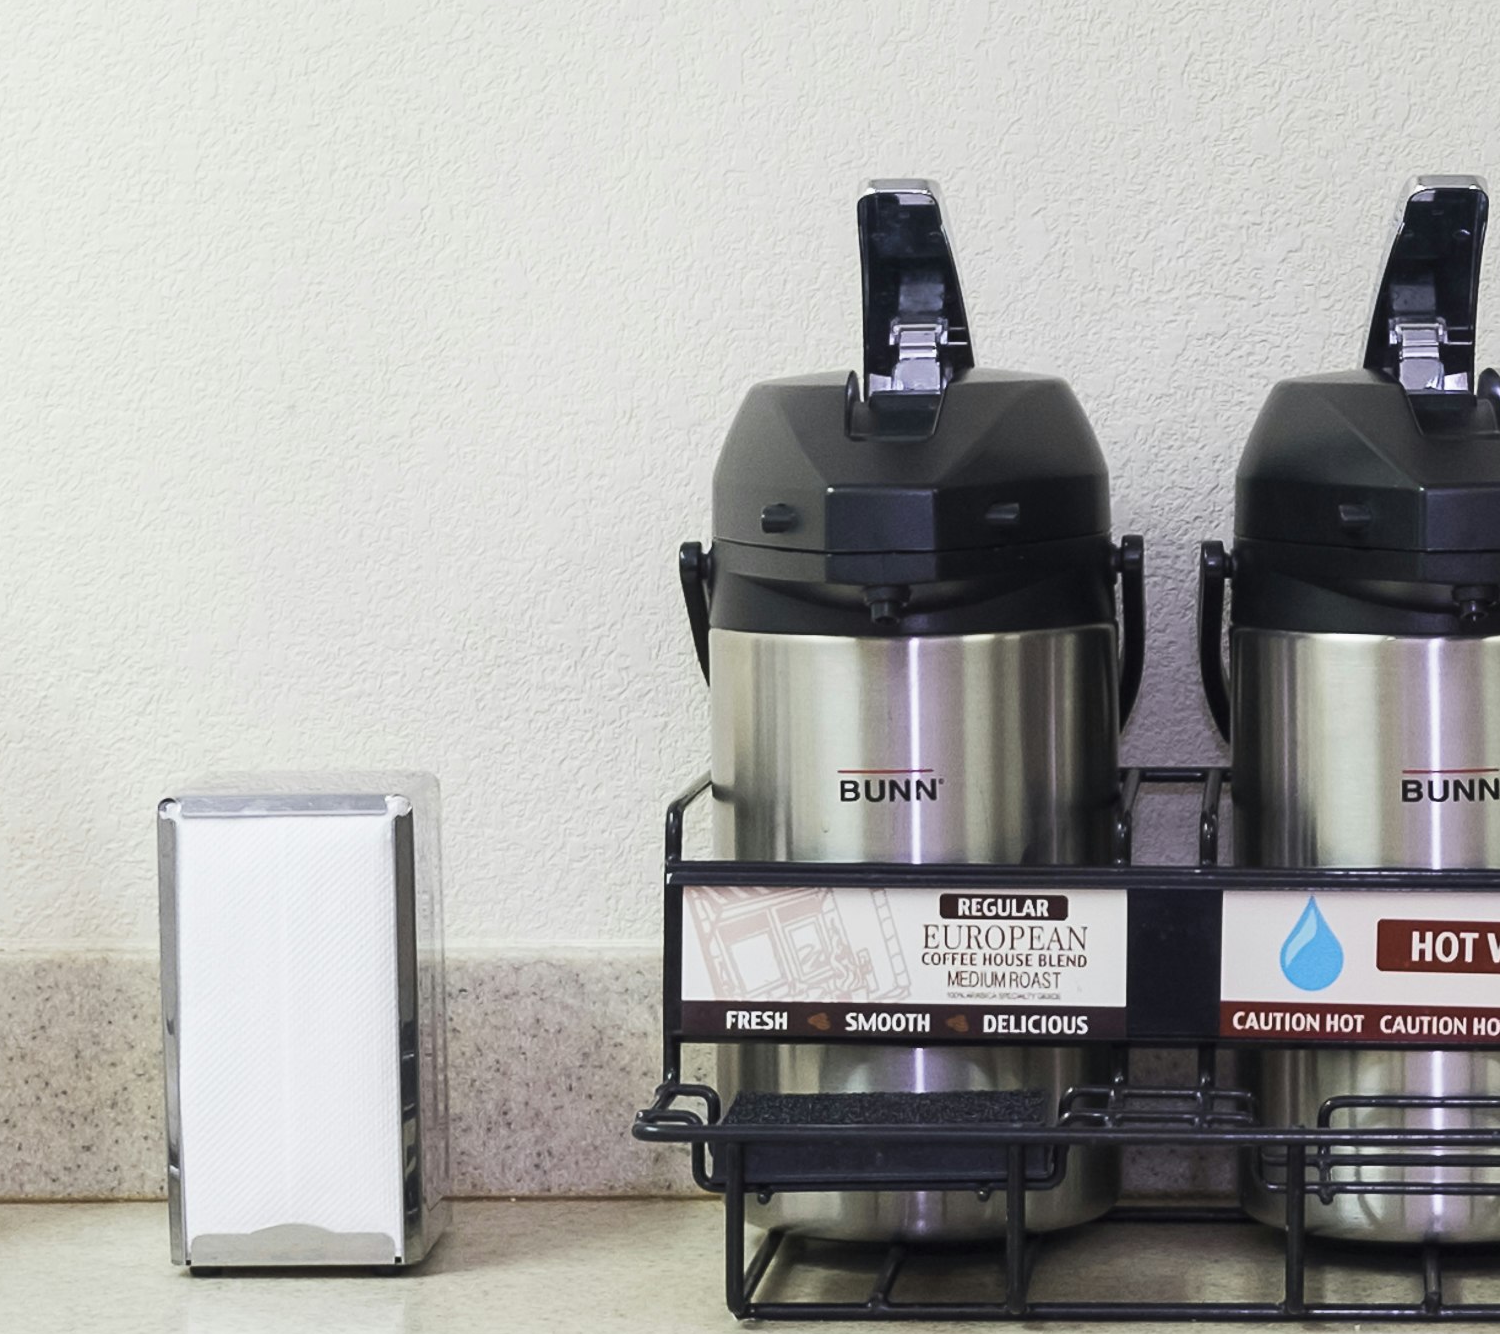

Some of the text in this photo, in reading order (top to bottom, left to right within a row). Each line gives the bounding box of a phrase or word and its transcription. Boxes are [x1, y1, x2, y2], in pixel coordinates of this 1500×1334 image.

[840, 778, 937, 802] BUNN
[1402, 778, 1500, 802] BUNN
[957, 898, 1049, 917] REGULAR
[923, 924, 1088, 951] EUROPEAN
[1411, 931, 1479, 963] HOT
[922, 952, 1087, 968] COFFEE HOUSE BLEND
[947, 970, 1061, 989] MEDIUM ROAST
[726, 1011, 1088, 1034] FRESH SMOOTH DELICIOUS
[1232, 1012, 1321, 1032] CAUTION
[1326, 1014, 1364, 1033] HOT
[1380, 1015, 1467, 1036] CAUTION
